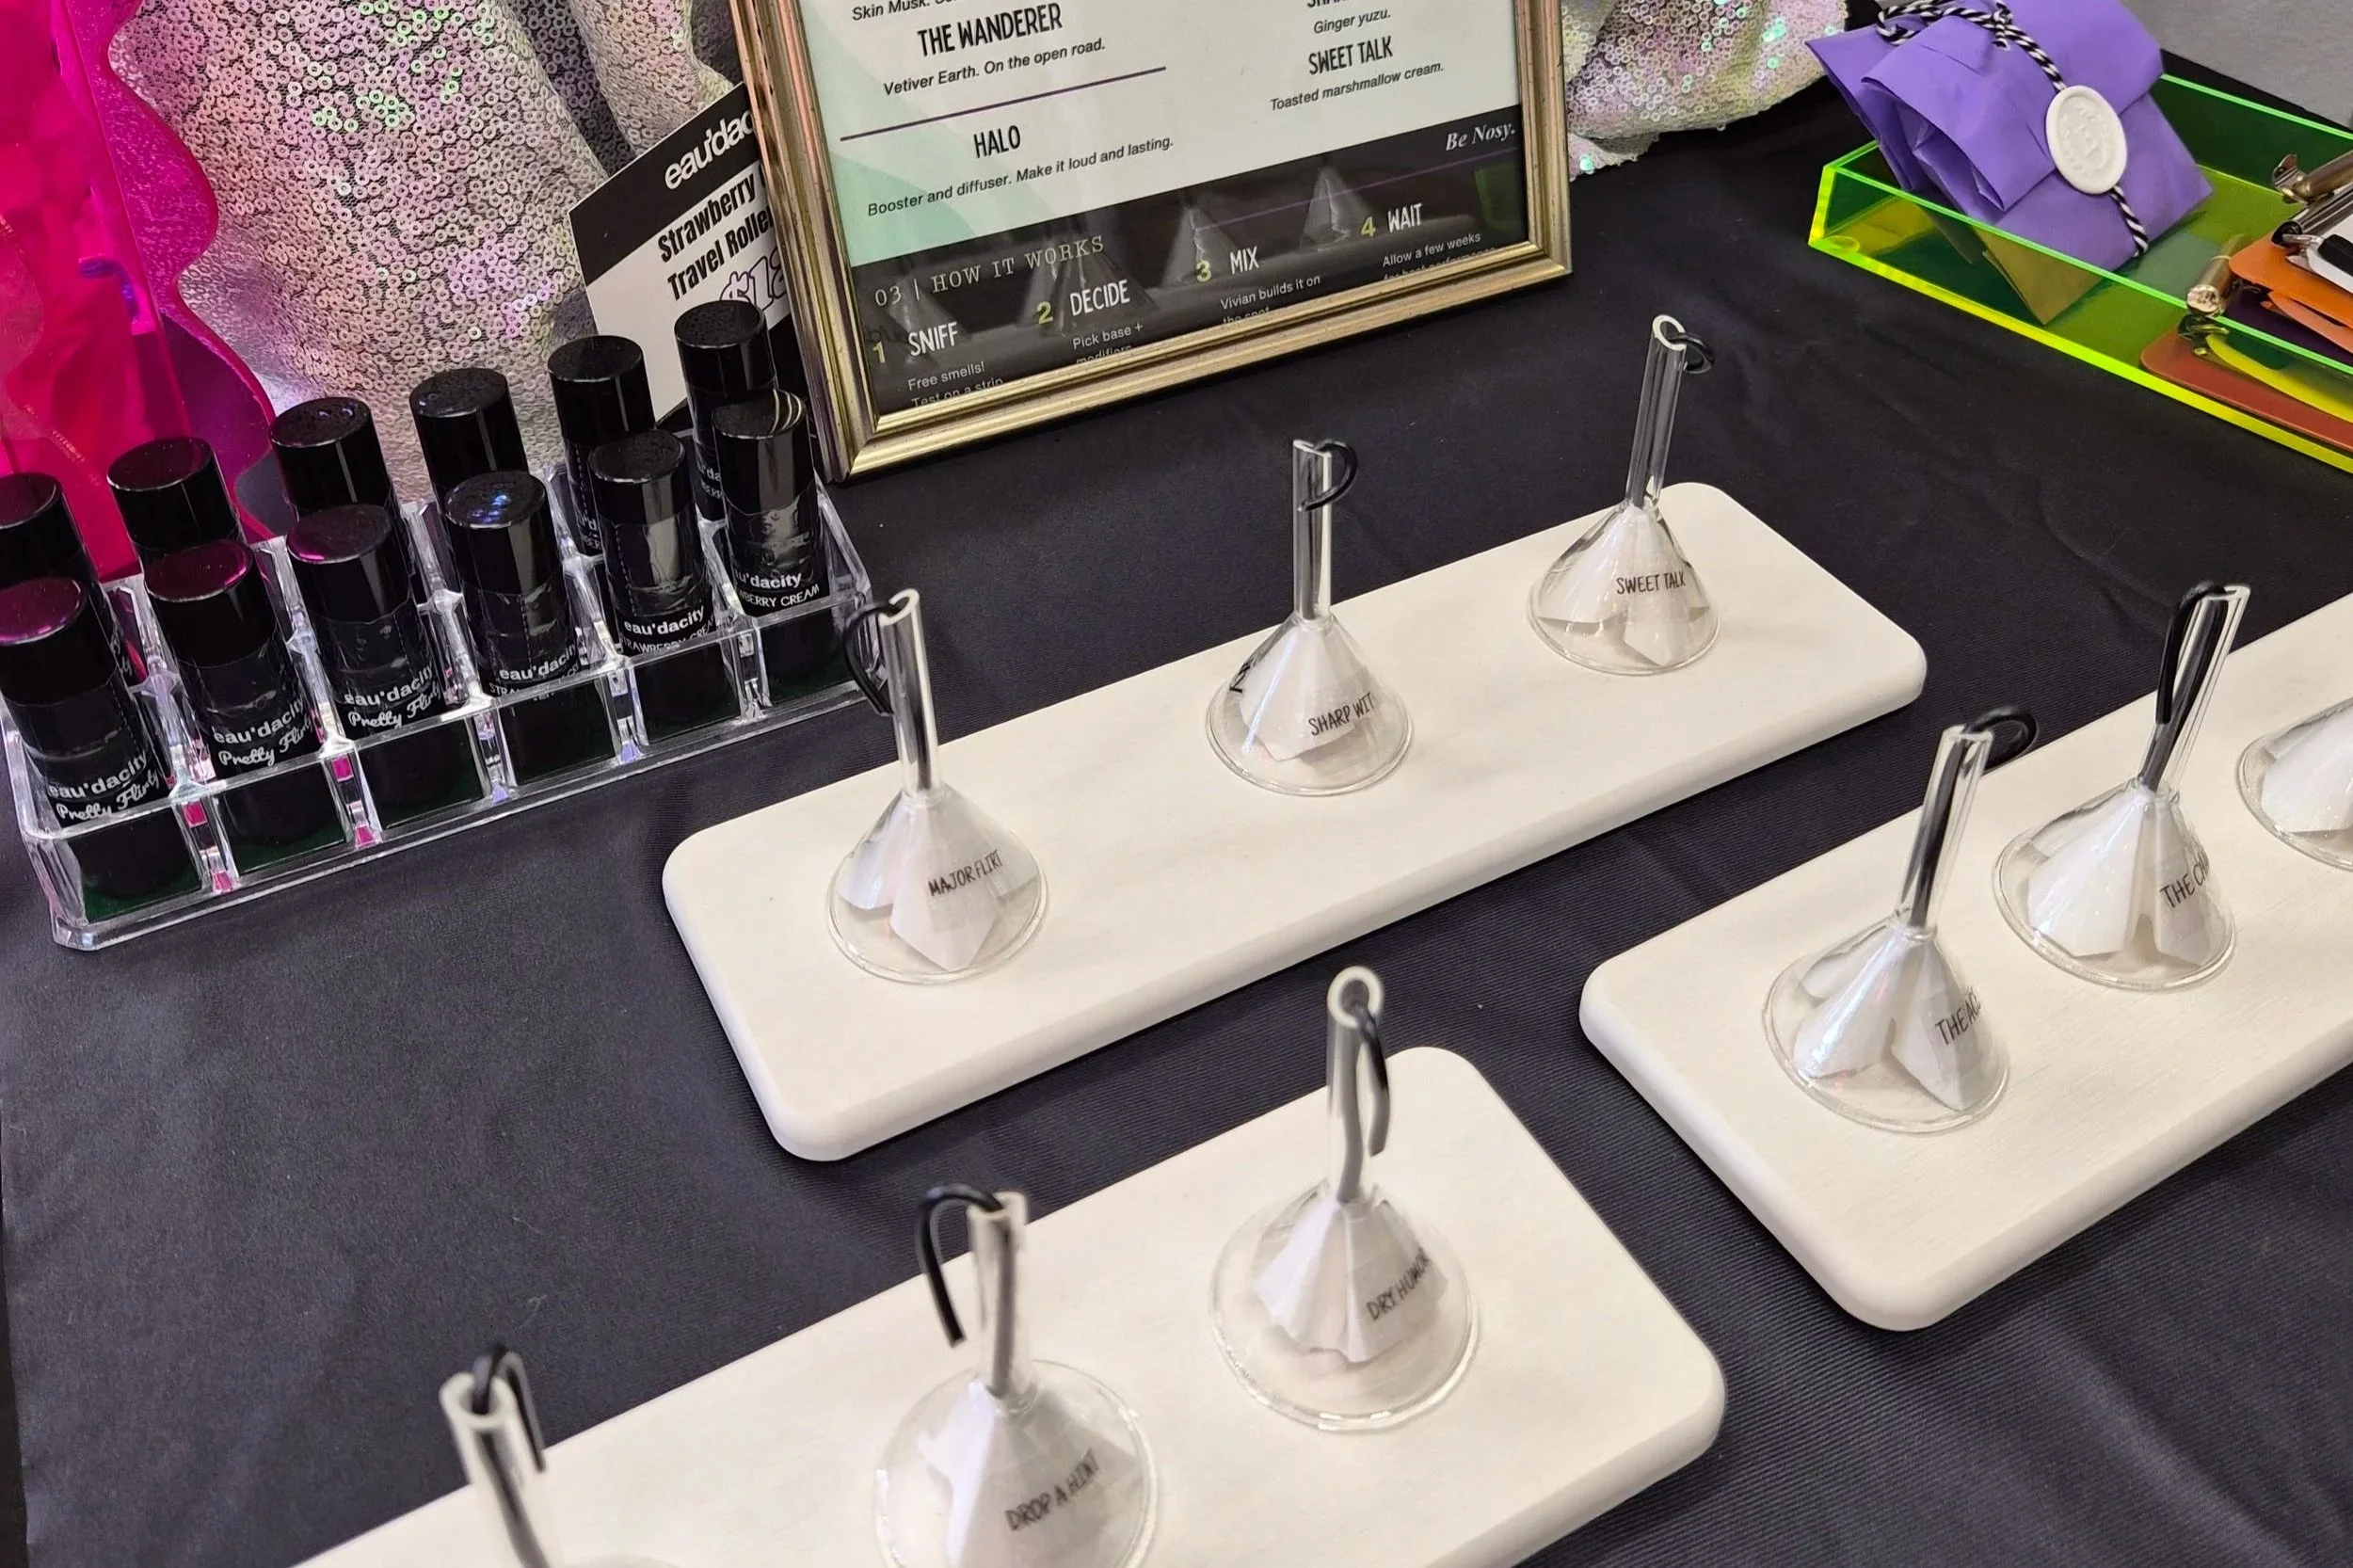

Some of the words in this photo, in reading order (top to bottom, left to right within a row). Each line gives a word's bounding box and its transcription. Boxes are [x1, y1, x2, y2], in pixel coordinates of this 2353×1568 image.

[853, 6, 884, 22] Skin
[918, 24, 954, 56] THE
[957, 3, 1063, 49] WANDERER
[1314, 16, 1355, 34] Ginger
[1358, 9, 1391, 27] yuzu.
[884, 75, 934, 96] Vetiver
[937, 65, 980, 85] Earth.
[984, 61, 1004, 74] On
[1007, 53, 1031, 70] the
[1034, 48, 1068, 66] open
[1071, 37, 1106, 56] road.
[1308, 44, 1353, 75] SWEET
[1357, 35, 1393, 65] TALK
[1271, 88, 1319, 111] Toasted
[1321, 72, 1401, 99] marshmallow
[1404, 61, 1446, 80] cream.
[974, 125, 1021, 158] HALO
[1446, 132, 1467, 152] Be
[1471, 121, 1516, 145] Nosy.
[868, 194, 923, 216] Booster
[926, 186, 952, 203] and
[956, 173, 1013, 197] diffuser.
[1016, 164, 1052, 183] Make
[1055, 160, 1064, 173] it
[1068, 152, 1096, 171] loud
[1099, 146, 1125, 163] and
[1128, 136, 1174, 157] lasting.
[658, 173, 756, 264] Strawberry
[1360, 216, 1376, 237] 4
[1388, 202, 1423, 232] WAIT
[1196, 260, 1211, 282] 3
[1230, 247, 1260, 275] MIX
[1383, 251, 1412, 268] Allow
[1415, 249, 1422, 259] a
[1424, 244, 1445, 256] few
[1447, 232, 1481, 249] weeks
[667, 241, 725, 301] Travel
[875, 285, 902, 307] 03
[930, 265, 982, 294] HOW
[992, 257, 1016, 279] IT
[1024, 235, 1104, 270] WORKS
[1036, 301, 1053, 325] 2
[1070, 280, 1130, 316] DECIDE
[1220, 294, 1256, 310] Vivian
[1258, 282, 1293, 300] builds
[1296, 279, 1304, 290] it
[1306, 276, 1321, 287] on
[872, 341, 886, 364] 1
[908, 322, 958, 357] SNIFF
[1073, 333, 1099, 349] Pick
[1102, 327, 1131, 342] base
[907, 376, 938, 391] Free
[940, 360, 985, 382] smells!
[781, 584, 820, 606] CREAM
[1616, 574, 1659, 595] SWEET
[1663, 571, 1686, 590] TALK
[624, 605, 704, 635] eau'dacity
[344, 661, 432, 706] eau'dacity
[213, 698, 303, 744] eau'dacity
[348, 711, 402, 729] Pretty
[1308, 705, 1350, 736] SHARP
[1353, 692, 1374, 718] WIT
[218, 746, 275, 766] Pretty
[48, 751, 147, 798] eau'dacity
[56, 802, 113, 820] Pretty
[928, 866, 975, 896] MAJOR
[2160, 873, 2195, 908] THE
[1935, 1007, 1968, 1045] THE
[1367, 1286, 1397, 1320] DRY
[1005, 1492, 1051, 1531] DROP
[1054, 1484, 1068, 1506] A
